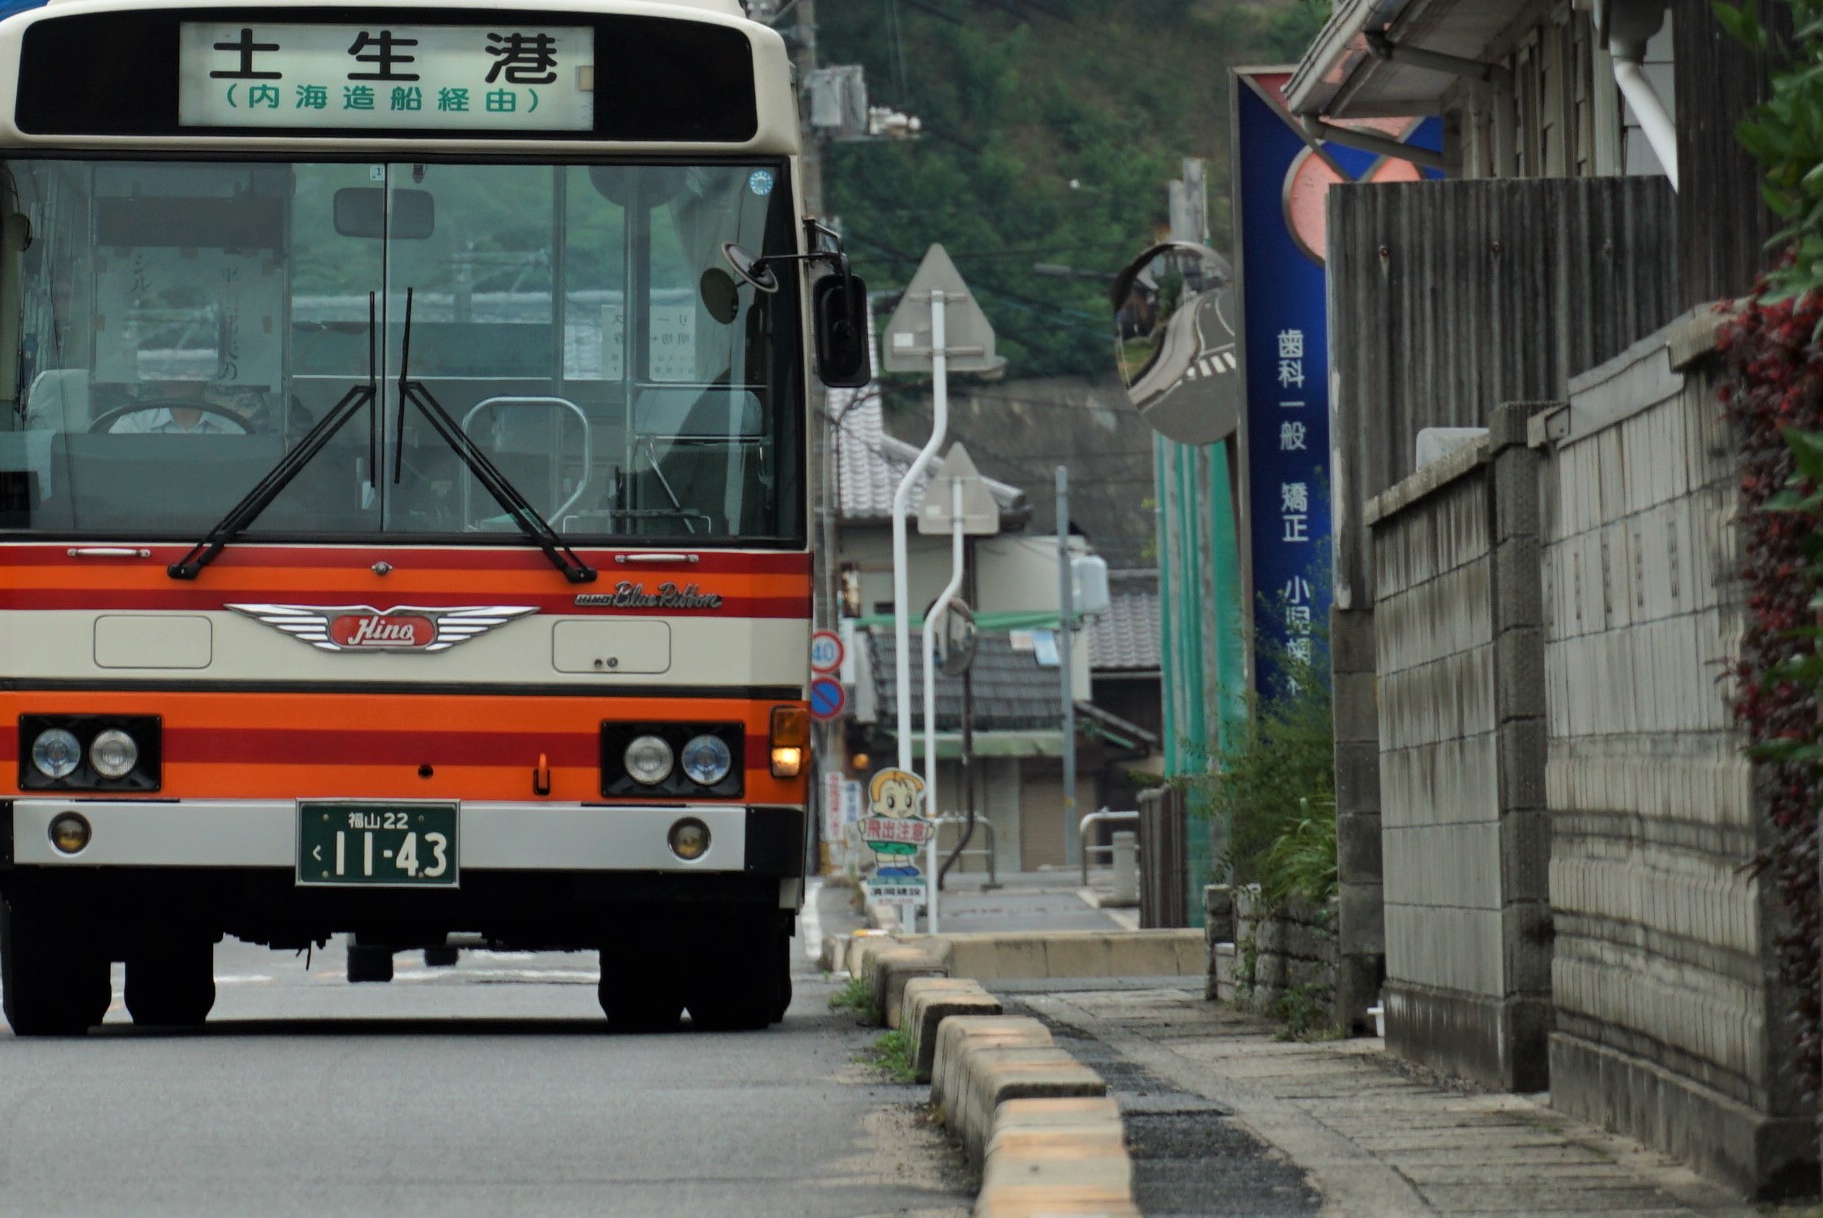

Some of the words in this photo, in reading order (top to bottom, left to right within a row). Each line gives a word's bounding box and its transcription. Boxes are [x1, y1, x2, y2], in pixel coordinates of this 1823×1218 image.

[209, 28, 558, 84] 土生港
[1277, 329, 1307, 451] 歯科一般
[1281, 482, 1309, 544] 矯正
[614, 580, 658, 607] Blue
[658, 581, 723, 608] Ribbon
[347, 615, 415, 645] Hino
[867, 818, 925, 842] 飛出注意
[312, 844, 322, 861] く
[336, 831, 448, 877] 11-43
